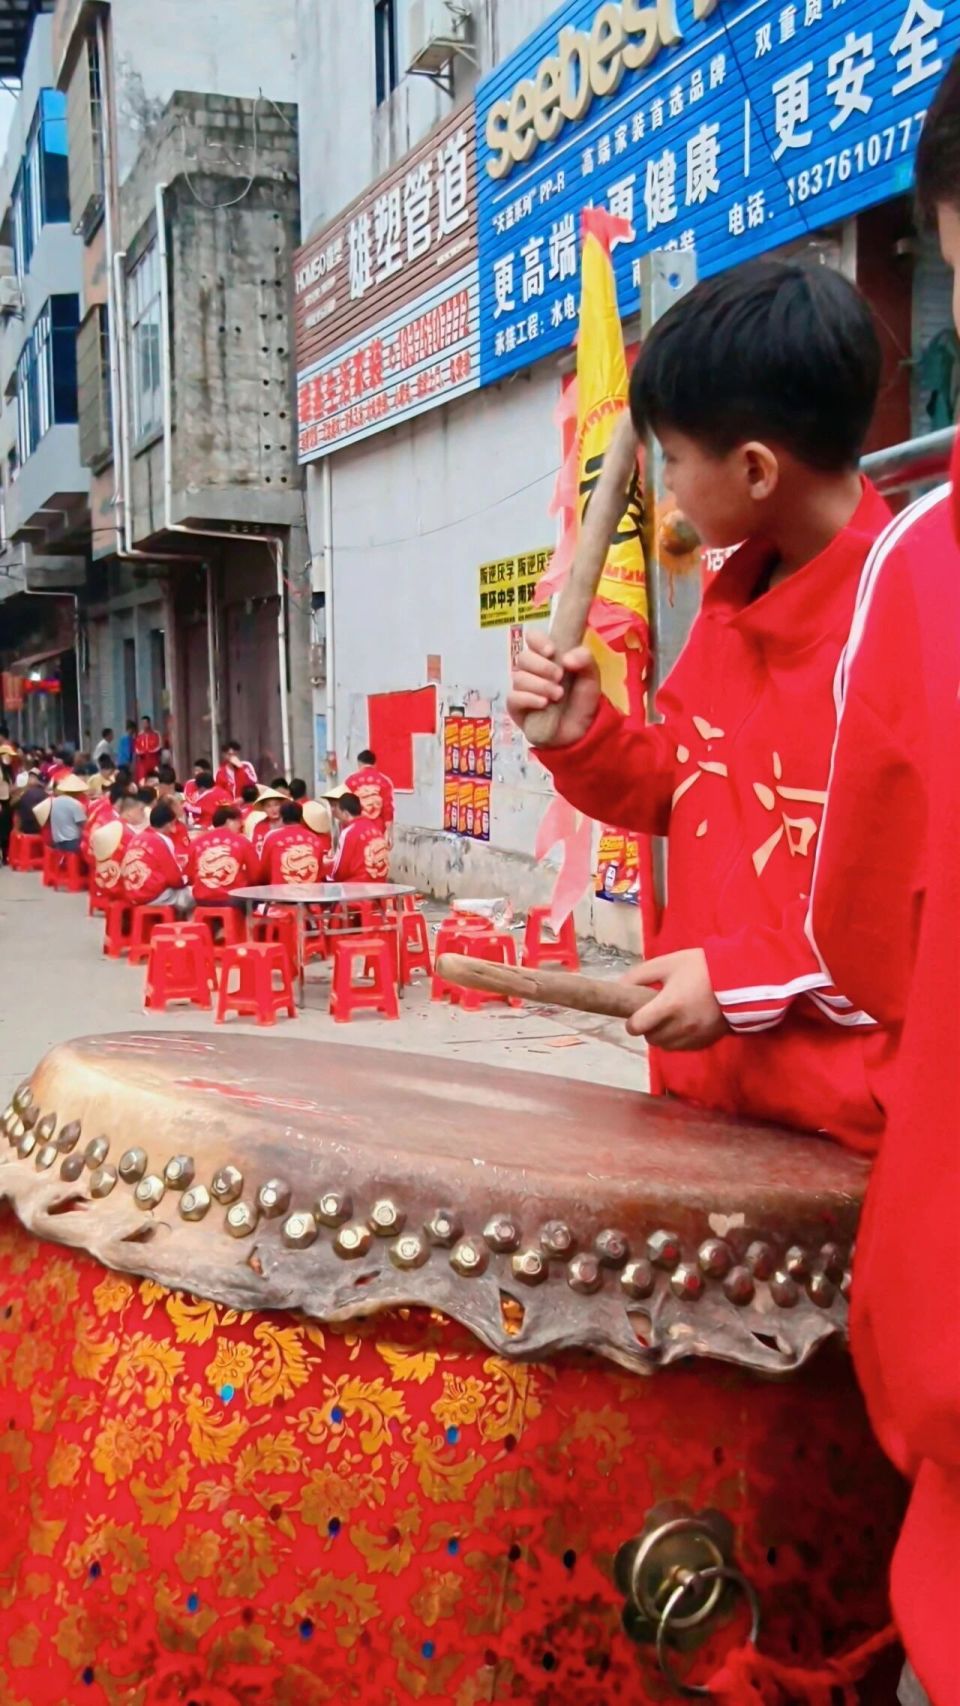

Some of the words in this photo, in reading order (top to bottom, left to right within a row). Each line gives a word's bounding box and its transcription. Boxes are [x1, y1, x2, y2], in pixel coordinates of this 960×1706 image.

[755, 0, 847, 58] 双重质
[493, 213, 577, 319] 更高端
[607, 121, 721, 232] 更健康
[771, 0, 944, 163] 更安全
[540, 171, 565, 204] PP-R
